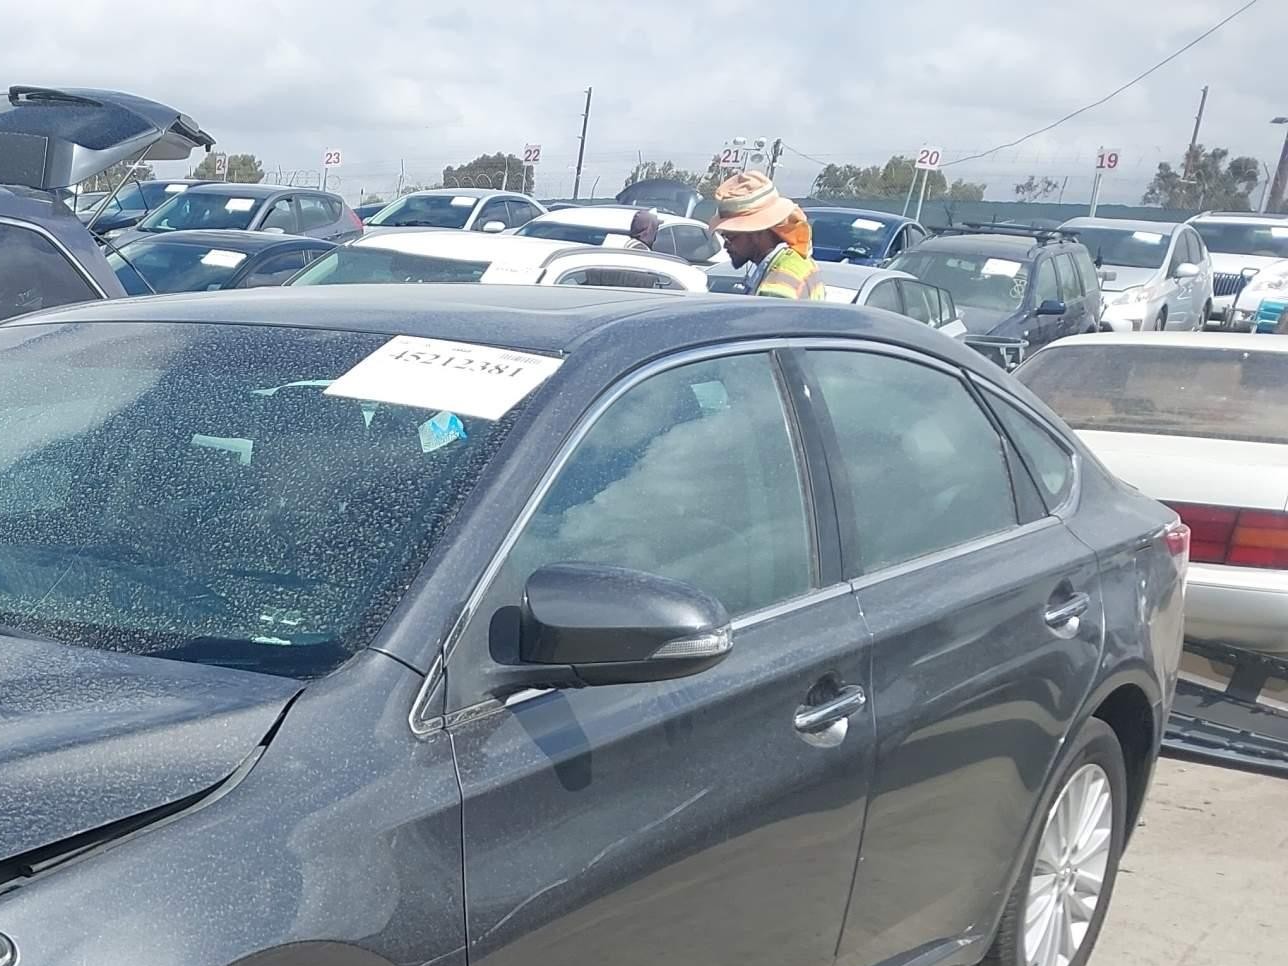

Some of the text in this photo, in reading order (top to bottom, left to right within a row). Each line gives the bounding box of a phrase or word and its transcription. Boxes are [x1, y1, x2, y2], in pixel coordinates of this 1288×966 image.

[324, 151, 341, 165] 23
[523, 149, 540, 162] 22
[721, 149, 740, 163] 21
[918, 149, 940, 165] 20
[1096, 152, 1119, 169] 19
[388, 350, 524, 378] 45212381
